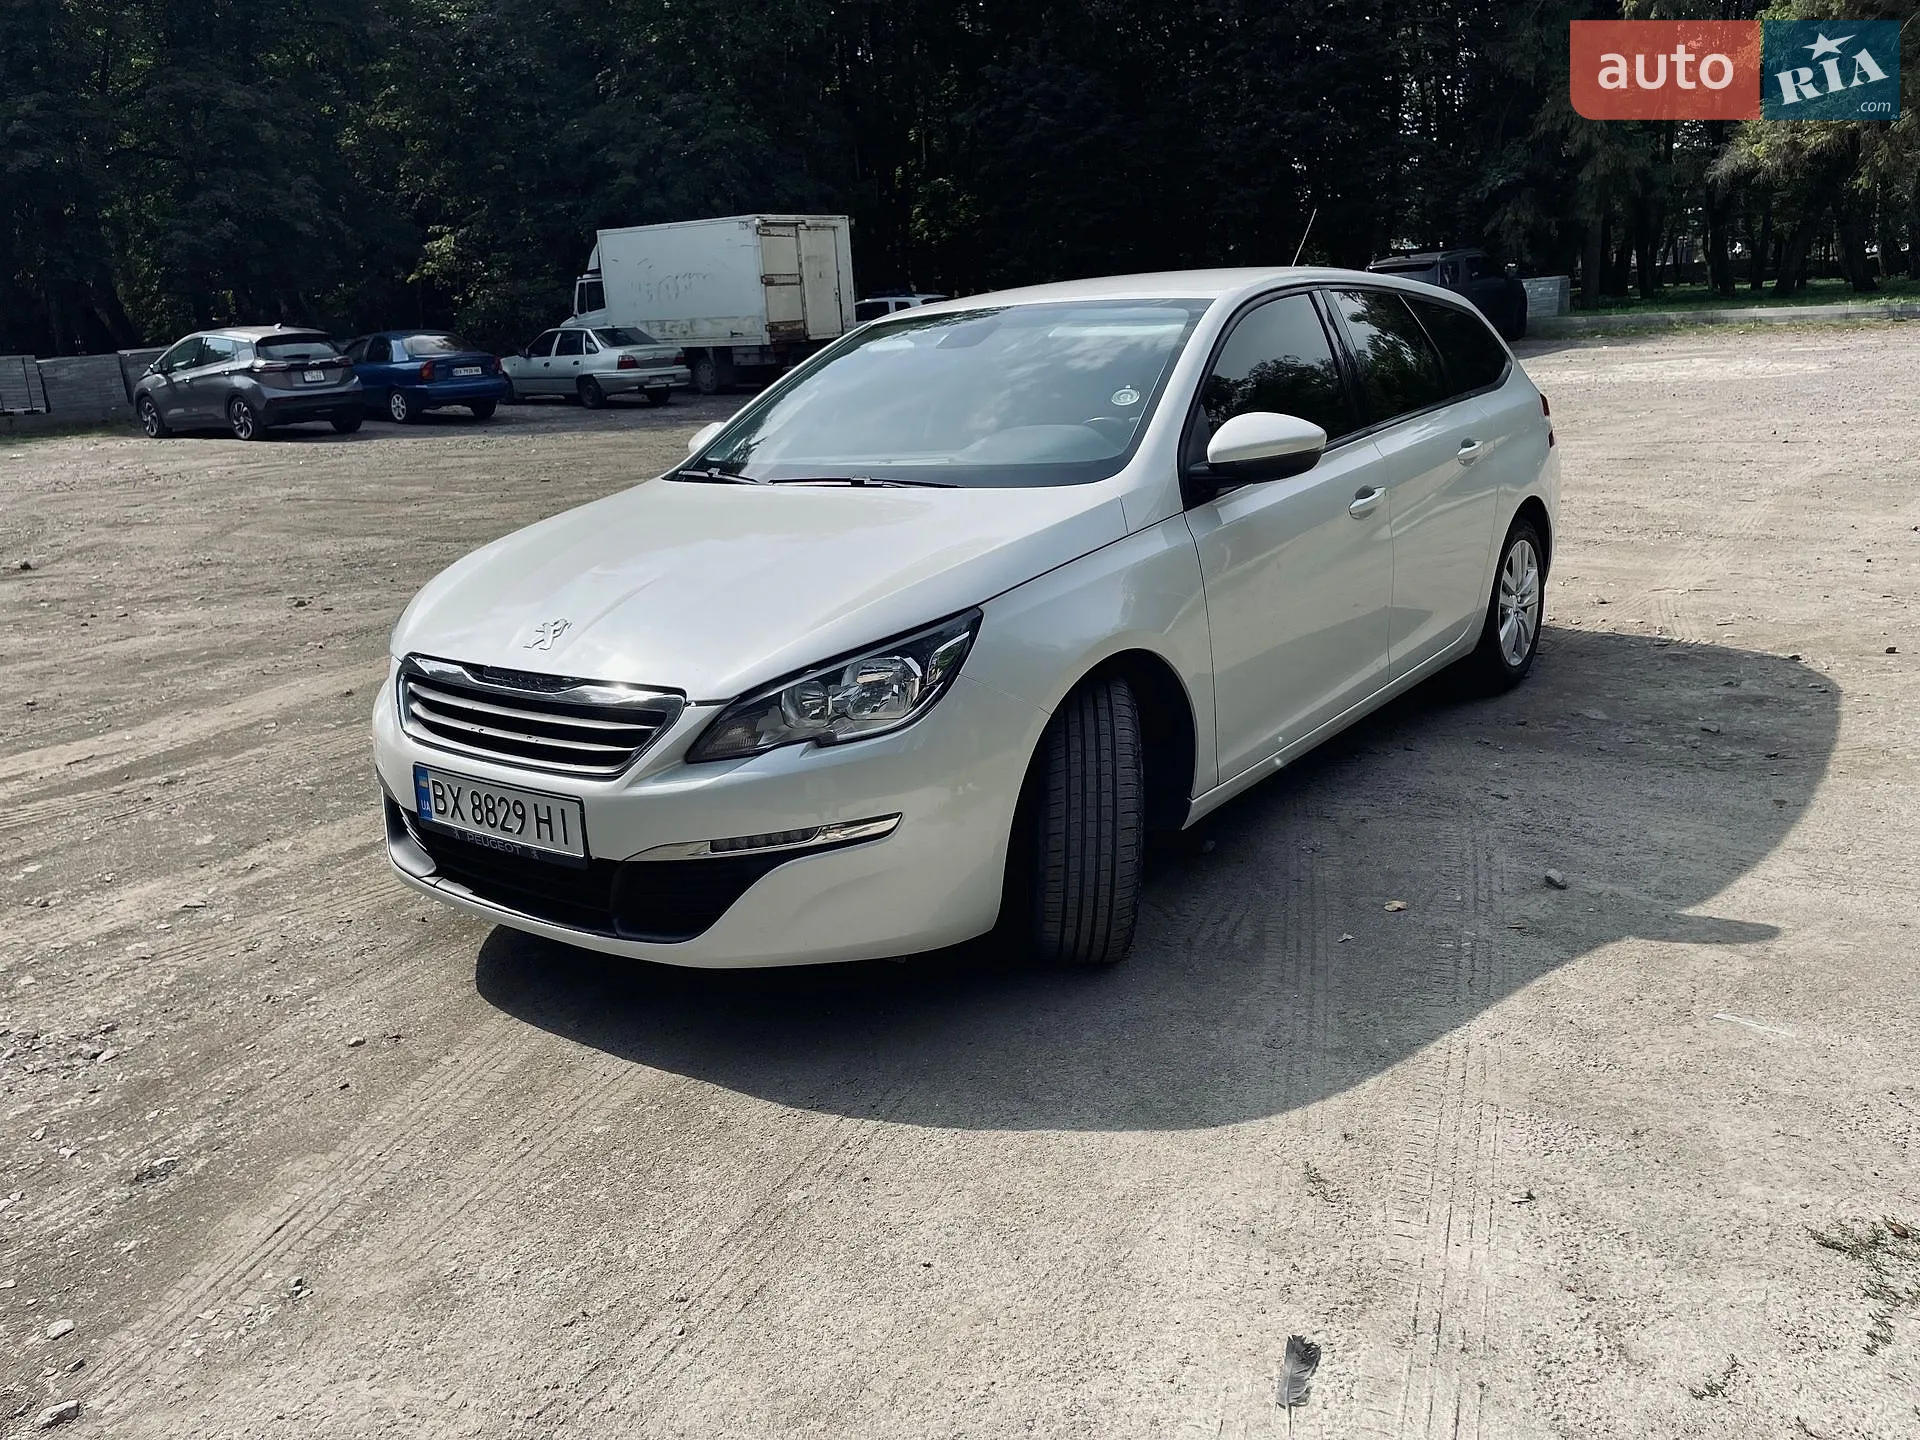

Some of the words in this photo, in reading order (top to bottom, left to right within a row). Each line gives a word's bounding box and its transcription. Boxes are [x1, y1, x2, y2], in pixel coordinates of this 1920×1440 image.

[421, 801, 432, 813] UA
[432, 780, 466, 822] BX
[471, 791, 527, 835] 8829
[533, 803, 569, 846] HI
[466, 832, 521, 855] PEUGEOT
